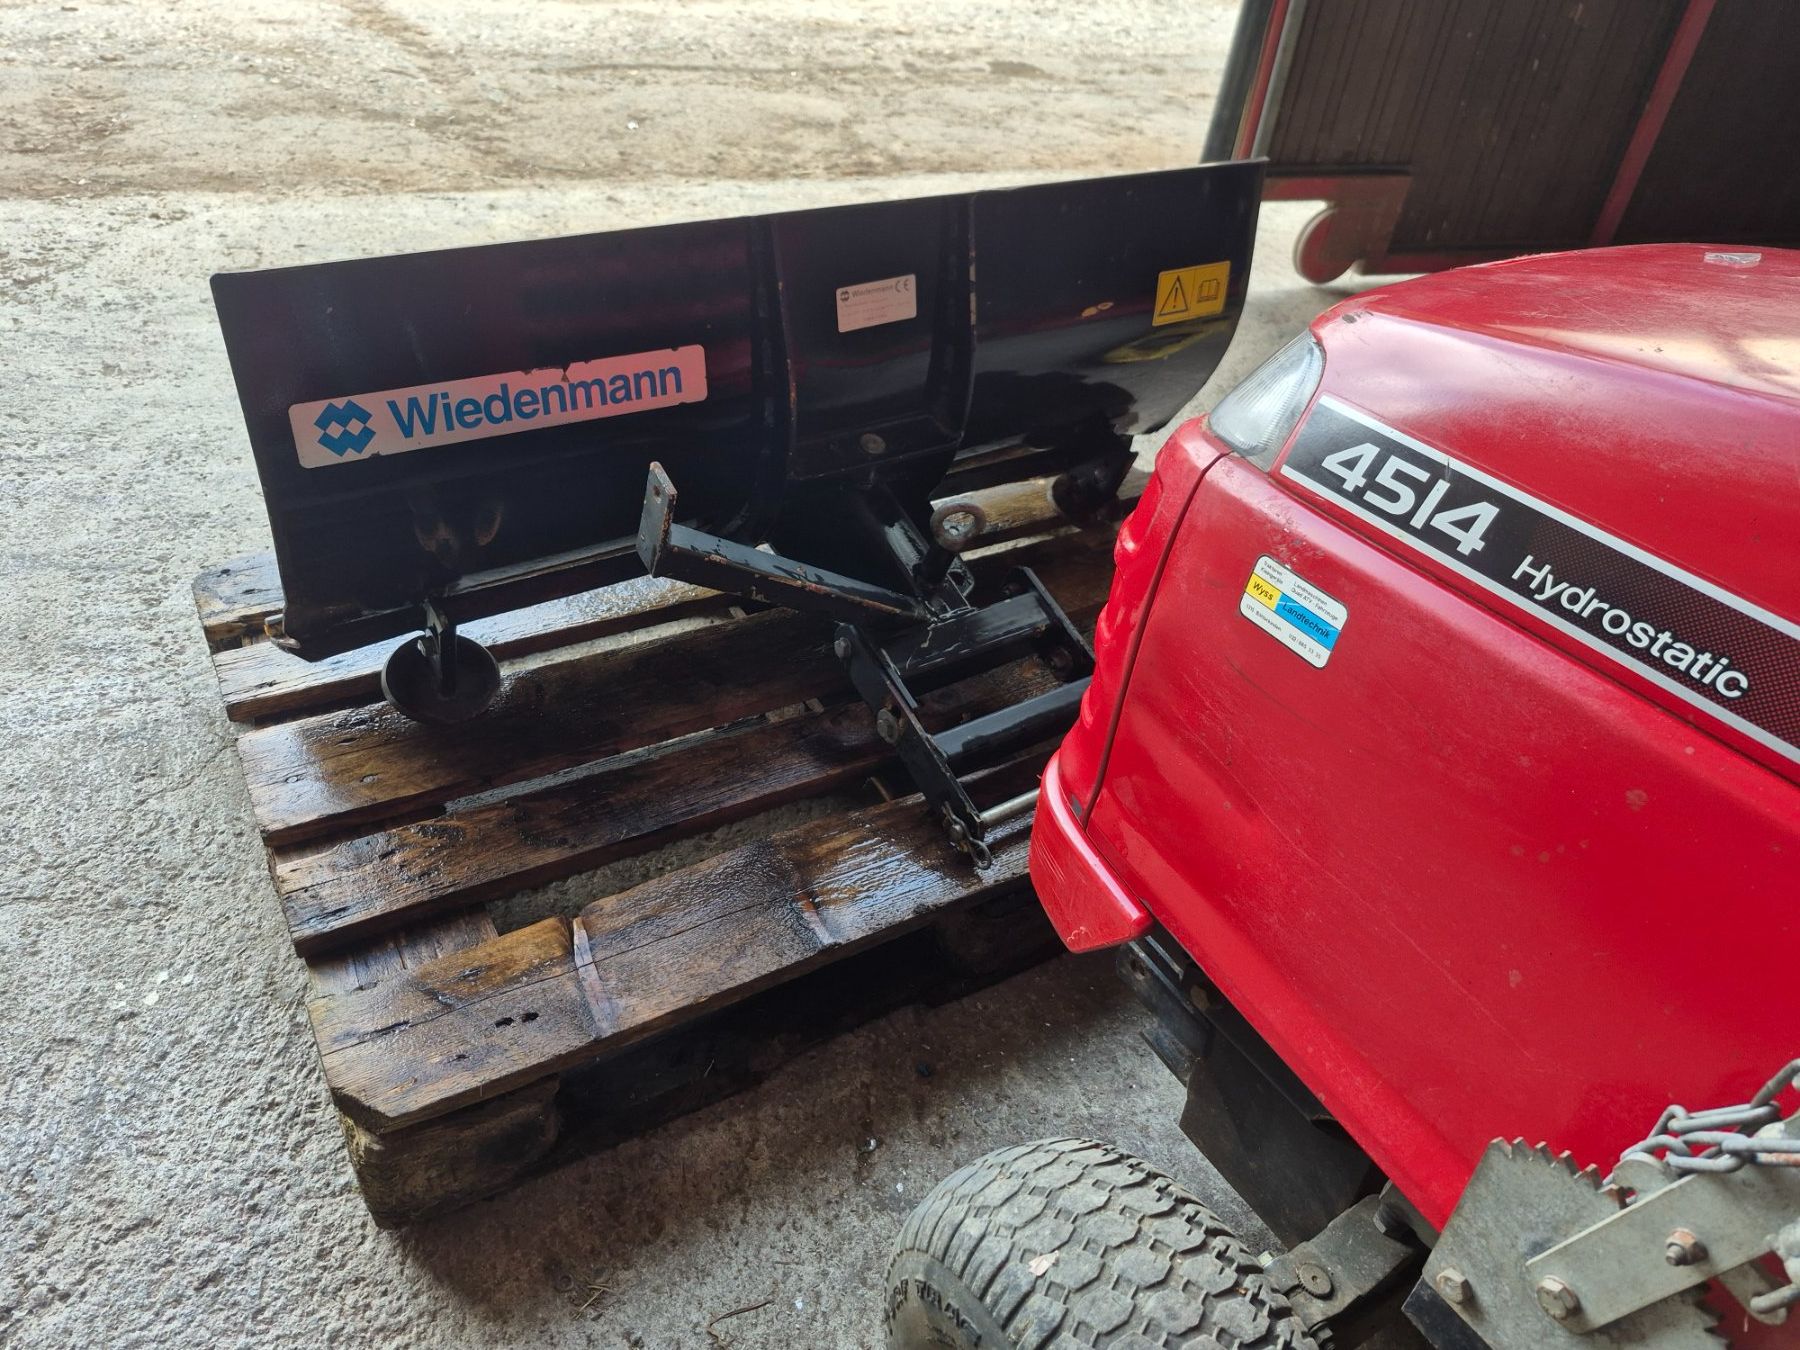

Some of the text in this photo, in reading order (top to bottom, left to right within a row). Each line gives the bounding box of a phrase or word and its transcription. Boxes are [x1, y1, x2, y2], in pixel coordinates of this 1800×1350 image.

[387, 365, 683, 439] Wiedenmann
[1321, 442, 1500, 556] 4514
[1253, 580, 1331, 640] Wyss Landtechnik
[1511, 555, 1750, 699] Hydrostatic
